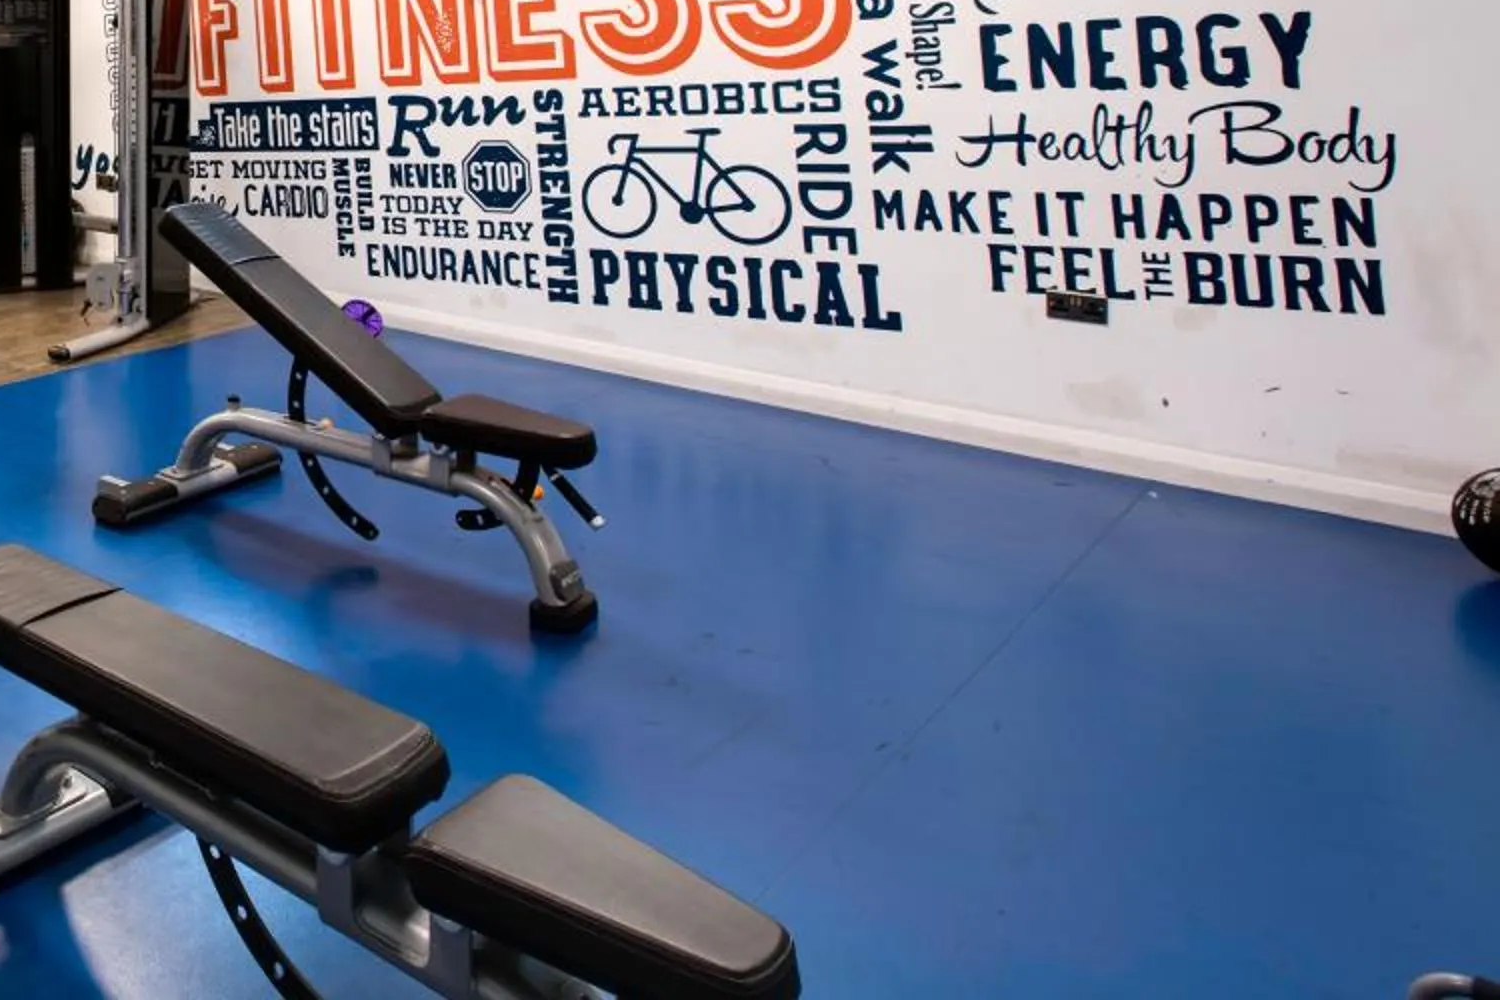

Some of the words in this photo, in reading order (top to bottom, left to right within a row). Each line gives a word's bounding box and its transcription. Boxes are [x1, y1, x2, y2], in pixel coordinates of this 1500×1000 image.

[905, 1, 962, 91] Shape!
[979, 11, 1312, 91] ENERGY
[212, 107, 263, 149] Take
[266, 104, 304, 148] the
[307, 106, 376, 147] stairs
[387, 94, 527, 158] Run
[578, 77, 841, 119] AEROBICS
[861, 38, 934, 174] walk
[231, 159, 328, 181] MOVING
[389, 163, 457, 189] NEVER
[470, 161, 524, 193] STOP
[956, 102, 1198, 187] Healthy
[1186, 100, 1396, 193] Body
[244, 184, 330, 220] CARDIO
[331, 158, 356, 258] MUSCLE
[354, 157, 375, 232] BUILD
[379, 195, 465, 216] TODAY
[533, 88, 580, 305] STRENGTH
[792, 122, 858, 256] RIDE
[875, 188, 1016, 235] MAKE
[1036, 191, 1085, 239] IT
[1110, 193, 1379, 248] HAPPEN
[381, 217, 407, 235] IS
[414, 218, 469, 239] THE
[477, 220, 534, 242] DAY
[366, 244, 542, 289] ENDURANCE
[590, 247, 903, 332] PHYSICAL
[987, 243, 1136, 301] FEEL
[1142, 250, 1175, 301] THE
[1183, 250, 1387, 316] BURN
